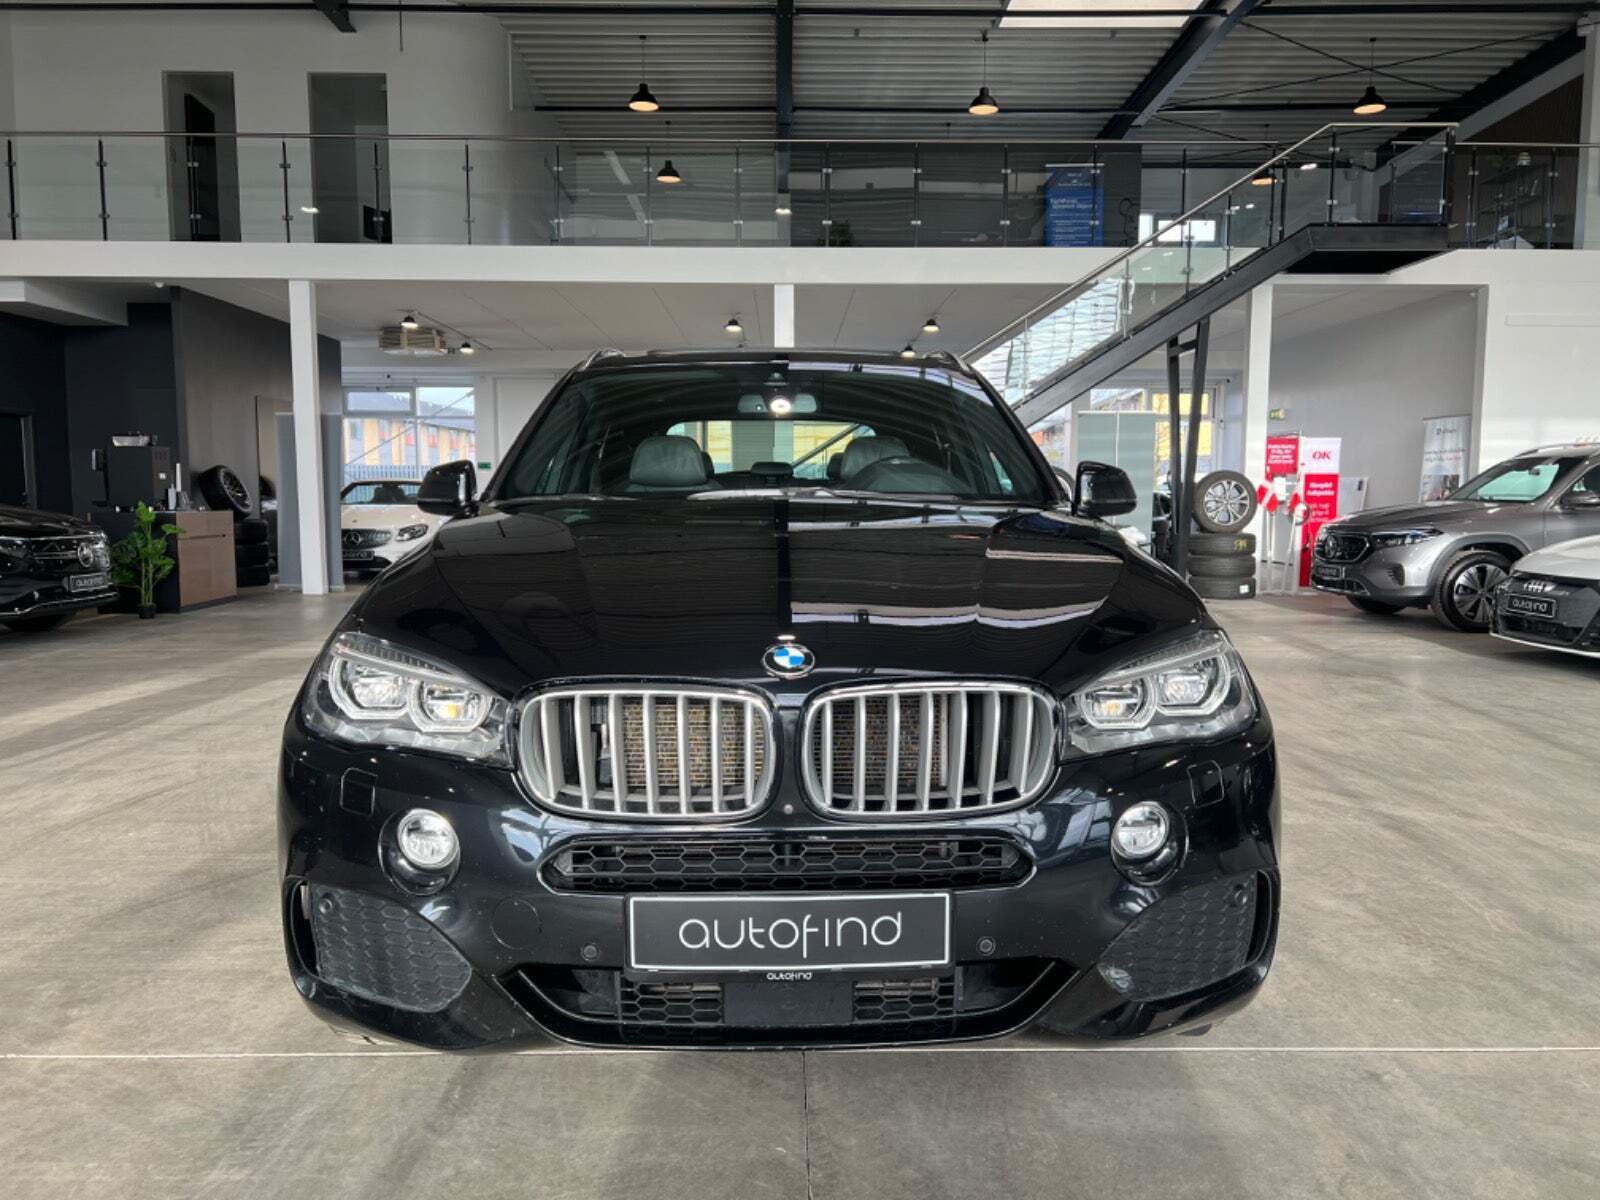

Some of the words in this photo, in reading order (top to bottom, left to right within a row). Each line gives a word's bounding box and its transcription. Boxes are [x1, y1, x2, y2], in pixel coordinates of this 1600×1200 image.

[1312, 450, 1332, 460] OK
[679, 911, 902, 959] autofind
[766, 971, 812, 982] autofind
